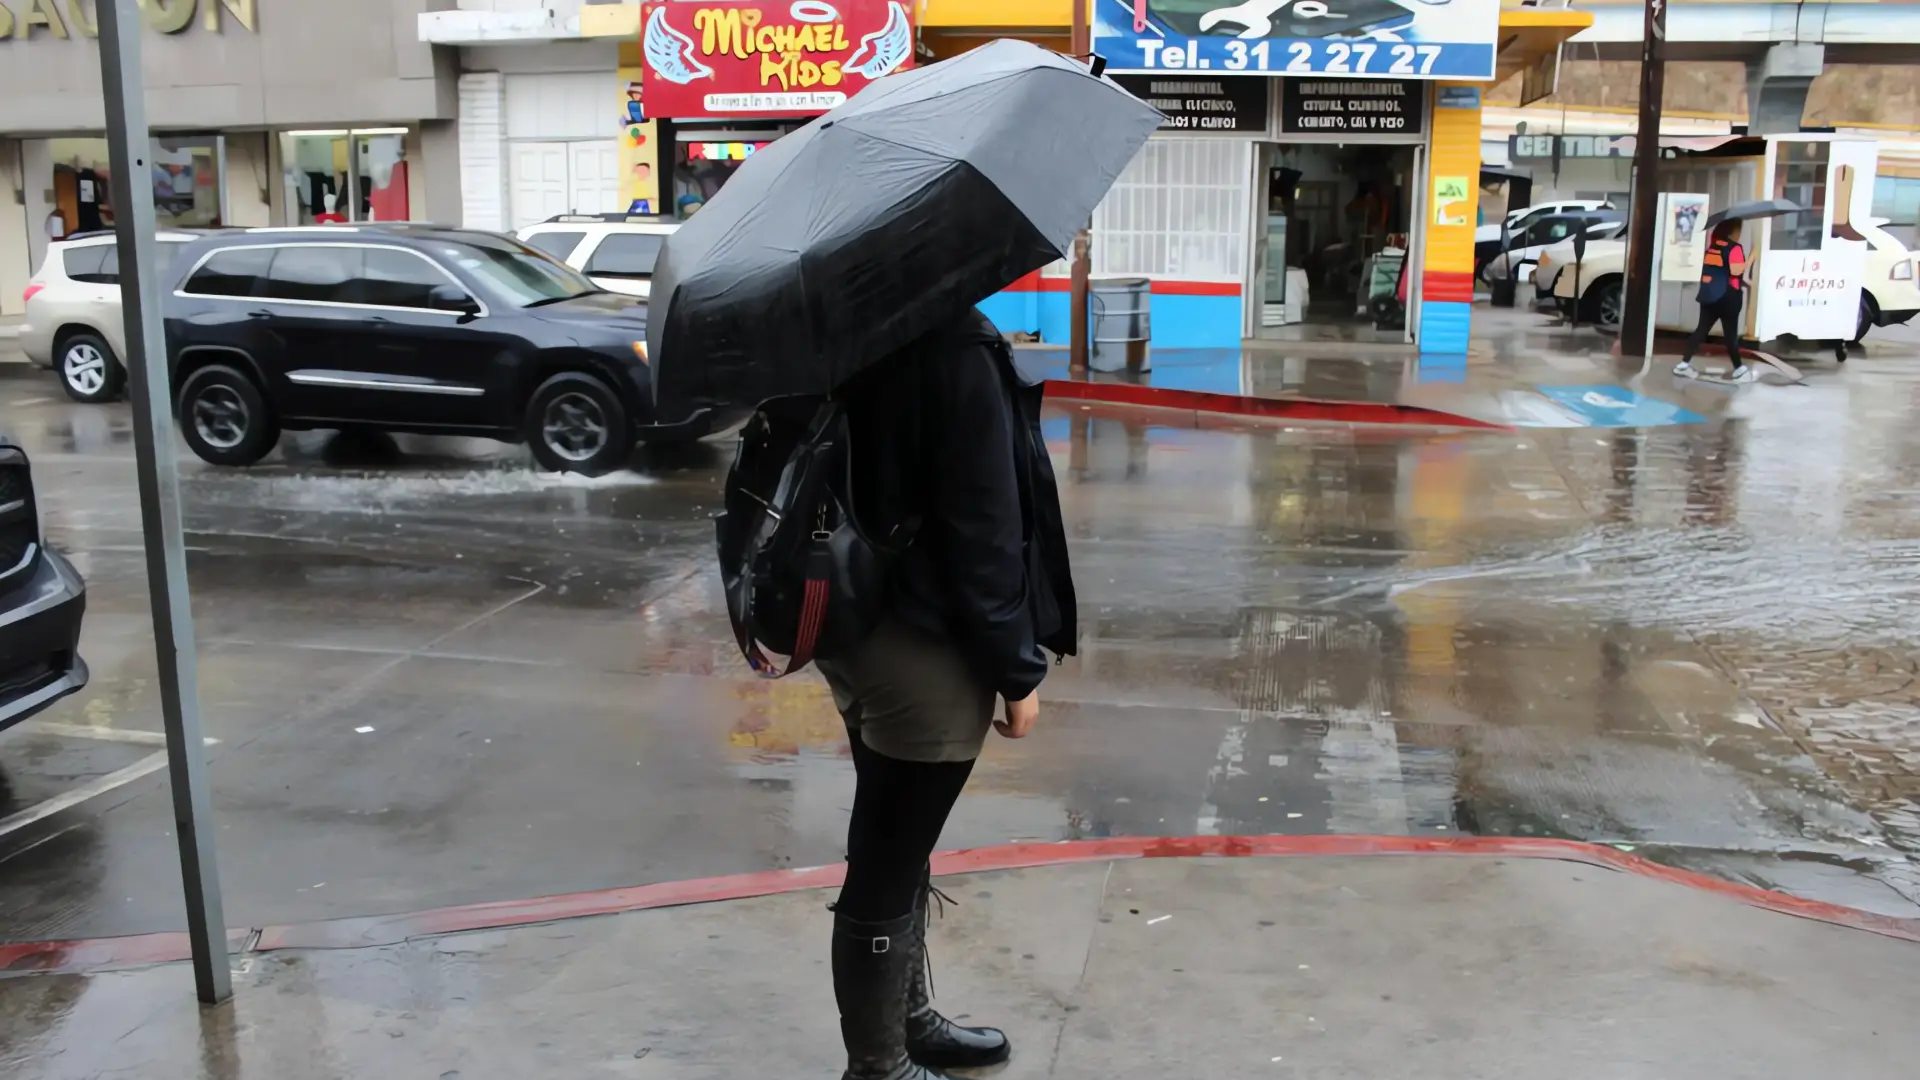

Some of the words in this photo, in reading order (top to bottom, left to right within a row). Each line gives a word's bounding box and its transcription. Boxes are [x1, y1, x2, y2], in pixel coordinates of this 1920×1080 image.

[1136, 39, 1209, 69] Tel.
[1224, 40, 1269, 70] 31
[1286, 41, 1312, 72] 2
[1324, 43, 1378, 74] 27
[1388, 44, 1442, 75] 27
